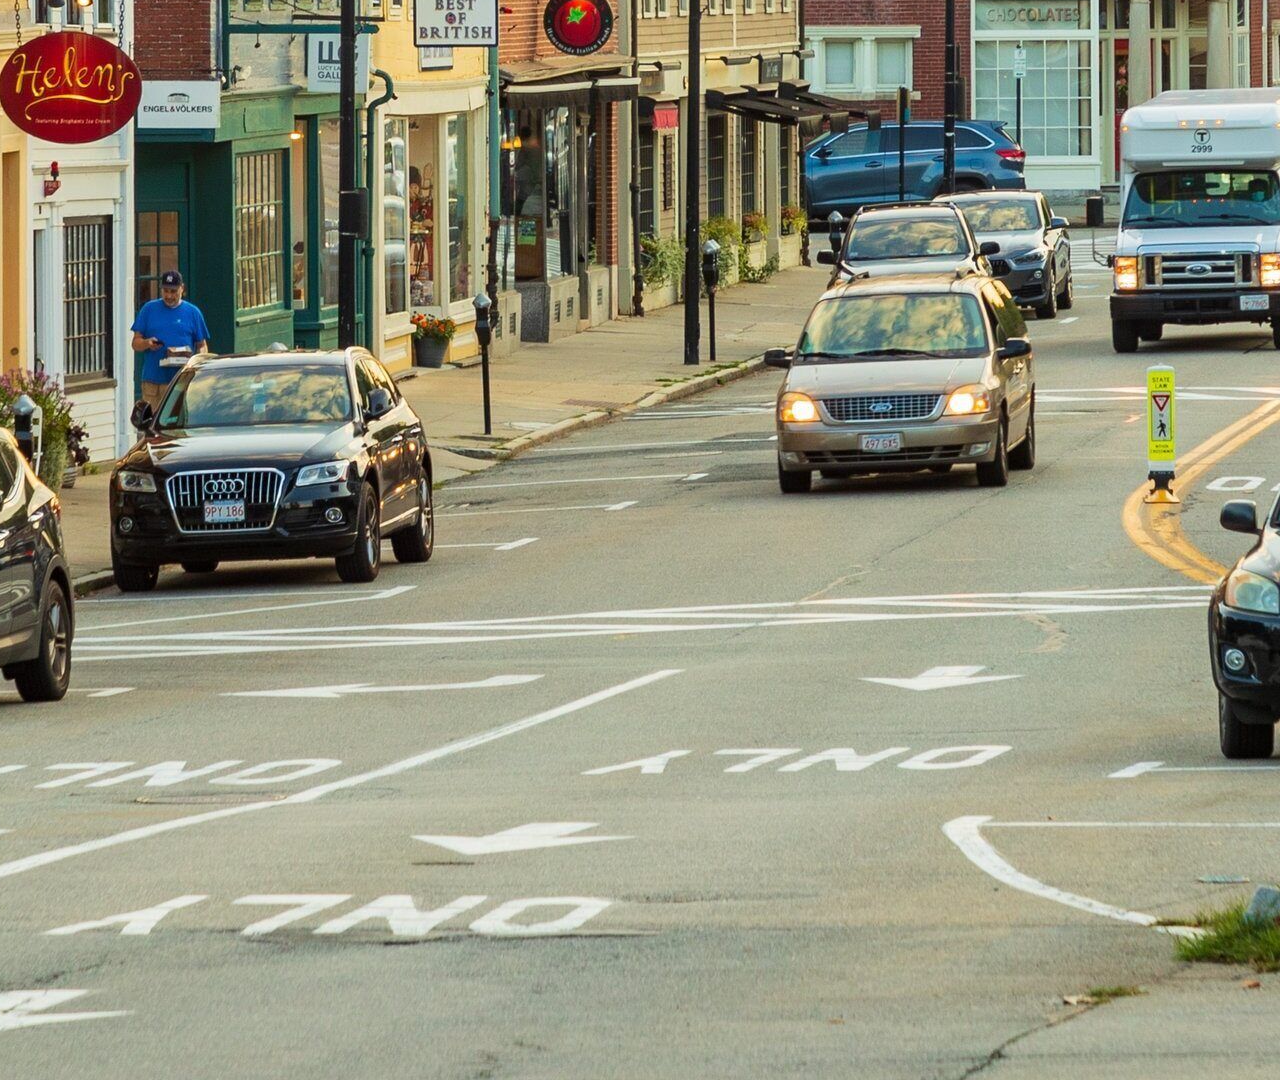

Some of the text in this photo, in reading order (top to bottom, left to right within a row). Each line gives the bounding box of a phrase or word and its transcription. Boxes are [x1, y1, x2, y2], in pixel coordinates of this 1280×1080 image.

[445, 12, 467, 25] OF
[987, 7, 1081, 23] CHOCOLATES
[420, 26, 492, 39] BRITISH
[12, 46, 134, 102] Helen's
[1191, 145, 1213, 153] 2999
[205, 506, 244, 517] 9PY 186
[583, 744, 1013, 775] ONLY
[44, 894, 615, 938] ONLY
